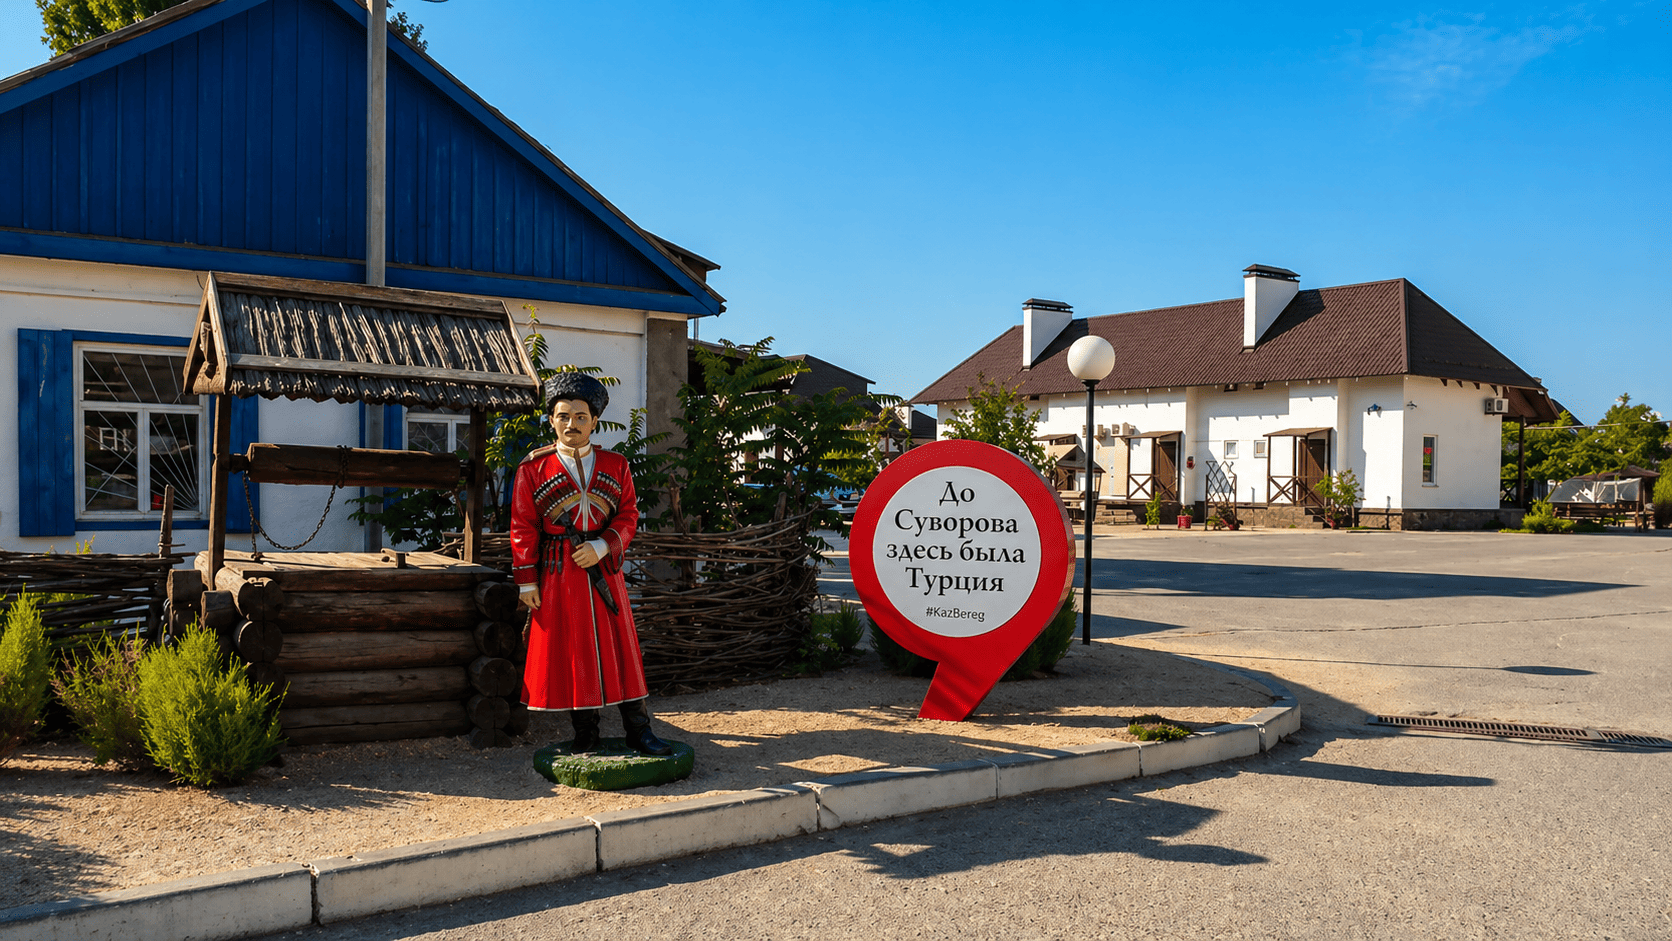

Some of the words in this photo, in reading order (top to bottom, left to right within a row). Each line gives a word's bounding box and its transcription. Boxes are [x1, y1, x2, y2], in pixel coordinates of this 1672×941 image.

[939, 481, 975, 506] До
[894, 509, 1019, 538] Суворова
[886, 543, 953, 562] здесь
[959, 539, 1026, 563] была
[905, 567, 1004, 596] Турция
[925, 606, 985, 622] #KazBereg
